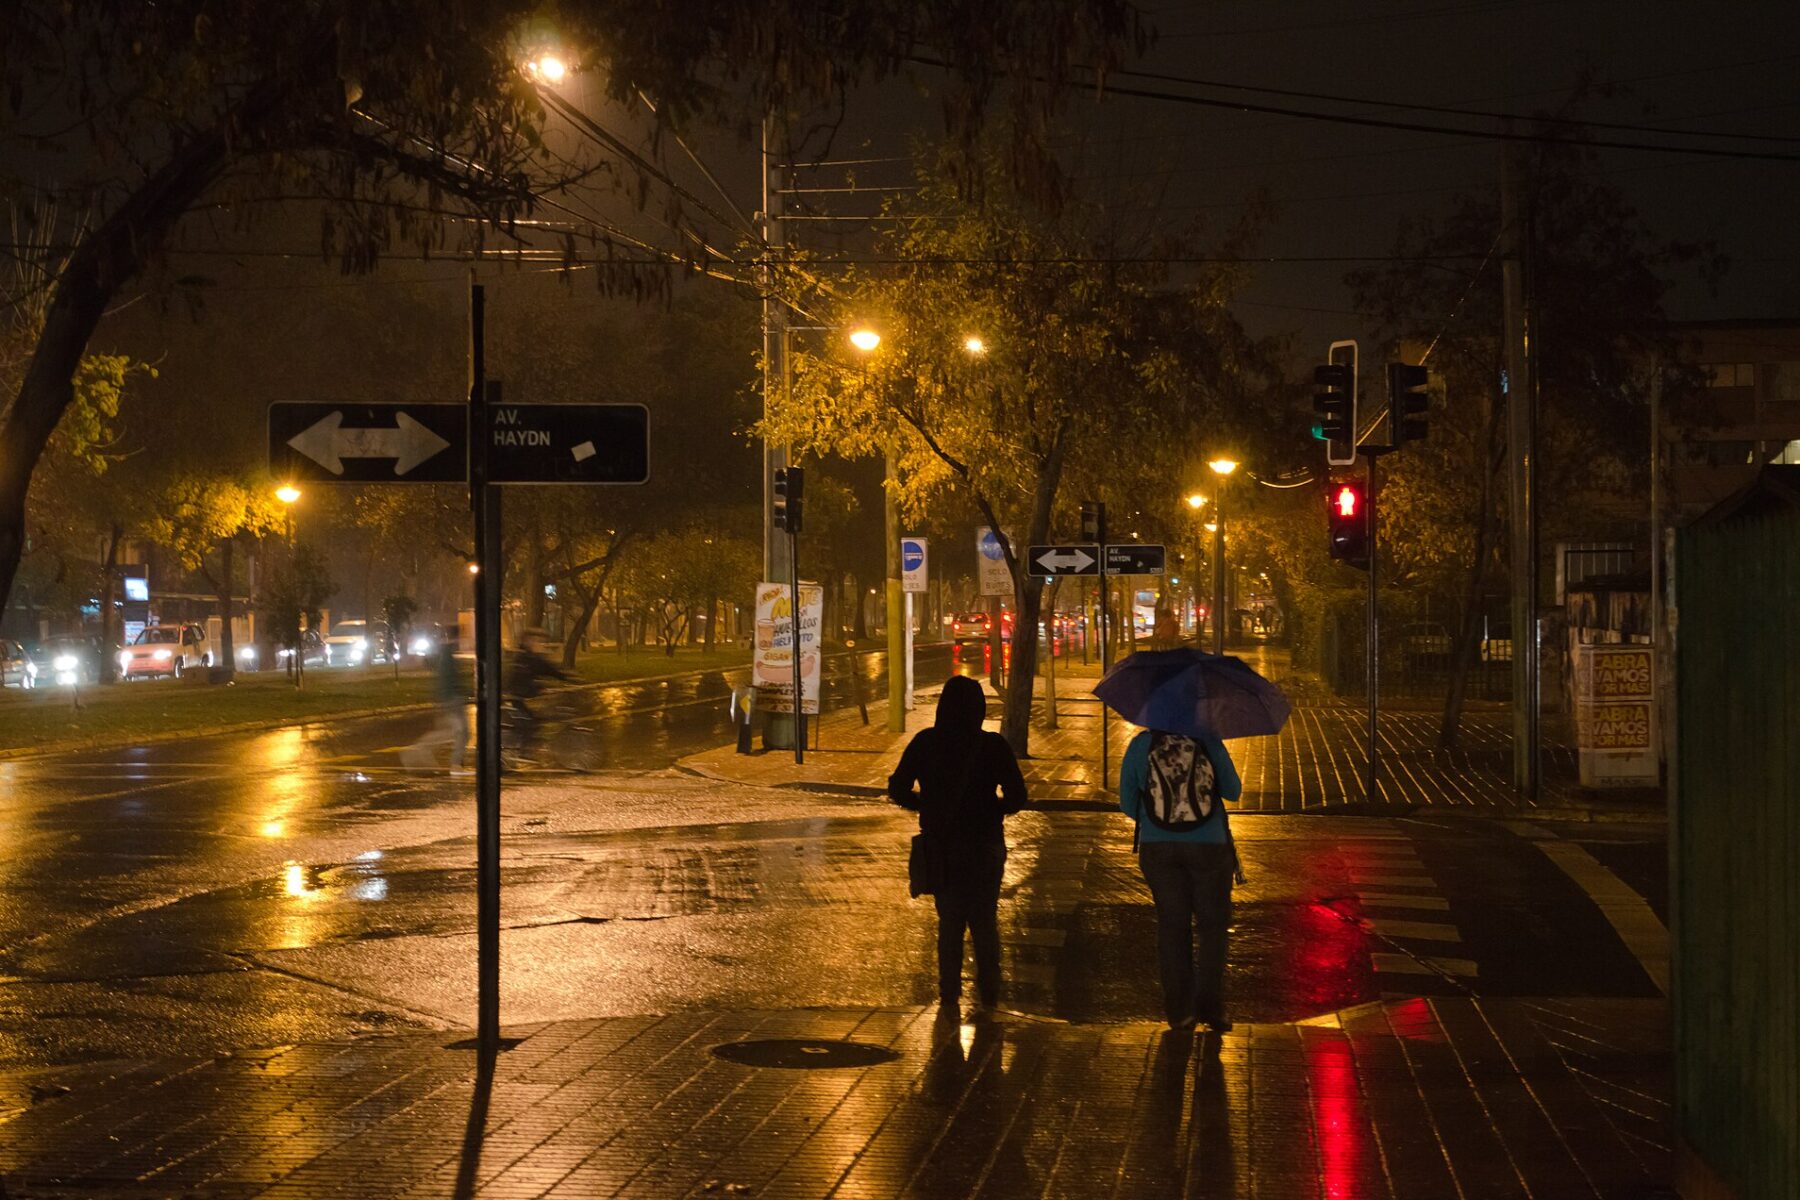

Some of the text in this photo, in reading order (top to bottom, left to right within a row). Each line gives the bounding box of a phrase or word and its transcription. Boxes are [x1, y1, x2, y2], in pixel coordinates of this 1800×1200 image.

[495, 409, 521, 425] AV.
[494, 430, 551, 446] HAYDN
[773, 617, 818, 636] HUELLOS
[1593, 669, 1649, 682] VAMOS
[1592, 721, 1647, 735] VAMOS
